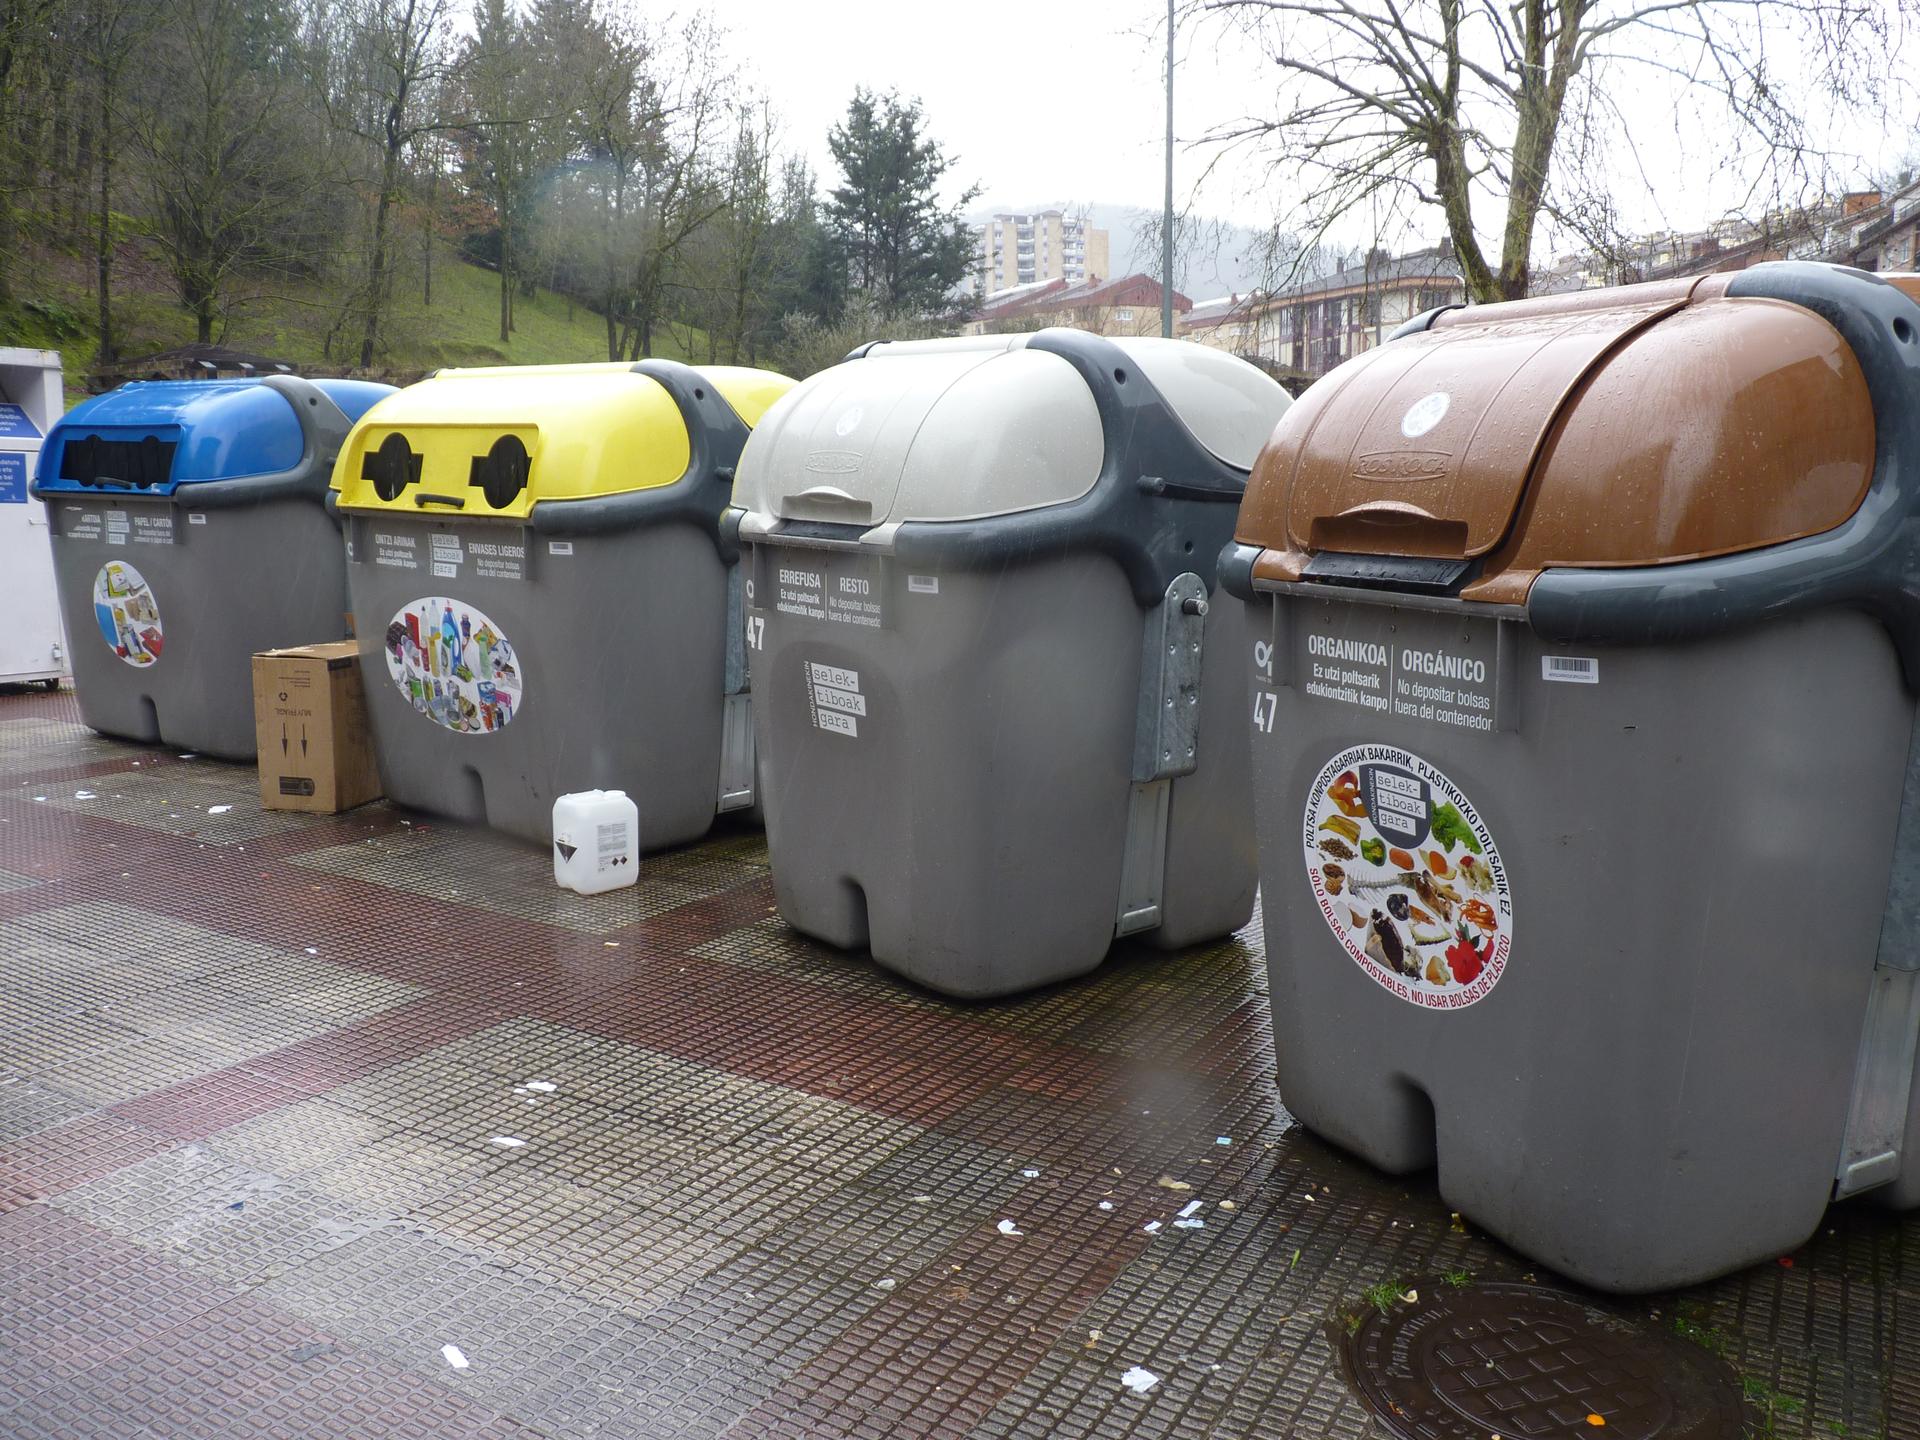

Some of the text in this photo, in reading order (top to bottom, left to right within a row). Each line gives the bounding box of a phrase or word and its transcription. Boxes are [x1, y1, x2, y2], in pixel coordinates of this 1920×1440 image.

[468, 542, 525, 558] ENVASES LIGEROS
[779, 569, 821, 588] ERREFUSA
[839, 576, 869, 595] RESTO
[781, 588, 787, 599] Ez
[787, 590, 796, 601] utzi
[829, 595, 838, 608] No
[837, 597, 862, 611] depositar
[828, 609, 842, 622] fuera
[842, 612, 852, 623] del
[747, 615, 765, 650] 47
[1308, 634, 1388, 667] ORGANIKOA
[814, 668, 856, 687] selek-
[1313, 663, 1380, 689] Ez utzi poltsarik
[1402, 649, 1485, 683] ORGÁNICO
[804, 660, 818, 728] HONDAKINEKIN
[816, 689, 861, 711] tiboak
[1306, 681, 1388, 711] edukiontzitik kanpo
[1397, 678, 1490, 710] No depositar bolsas
[820, 713, 850, 730] gara
[1253, 692, 1277, 733] 47
[1395, 697, 1493, 731] fuera del contenedor
[1377, 775, 1418, 793] selek-
[1379, 792, 1421, 815] tiboak
[1305, 747, 1511, 917] POLTSA KONPOSTAGARRIAK BAKARRIK, PLASTIKOZKO POLTSARIK EZ
[1380, 812, 1408, 829] gara
[1319, 898, 1346, 940] BOLSAS
[1344, 939, 1410, 1001] COMPOSTABLES,
[1411, 989, 1424, 1004] NO
[1425, 993, 1449, 1008] USAR
[1449, 985, 1480, 1008] BOLSAS
[1478, 977, 1491, 994] DE
